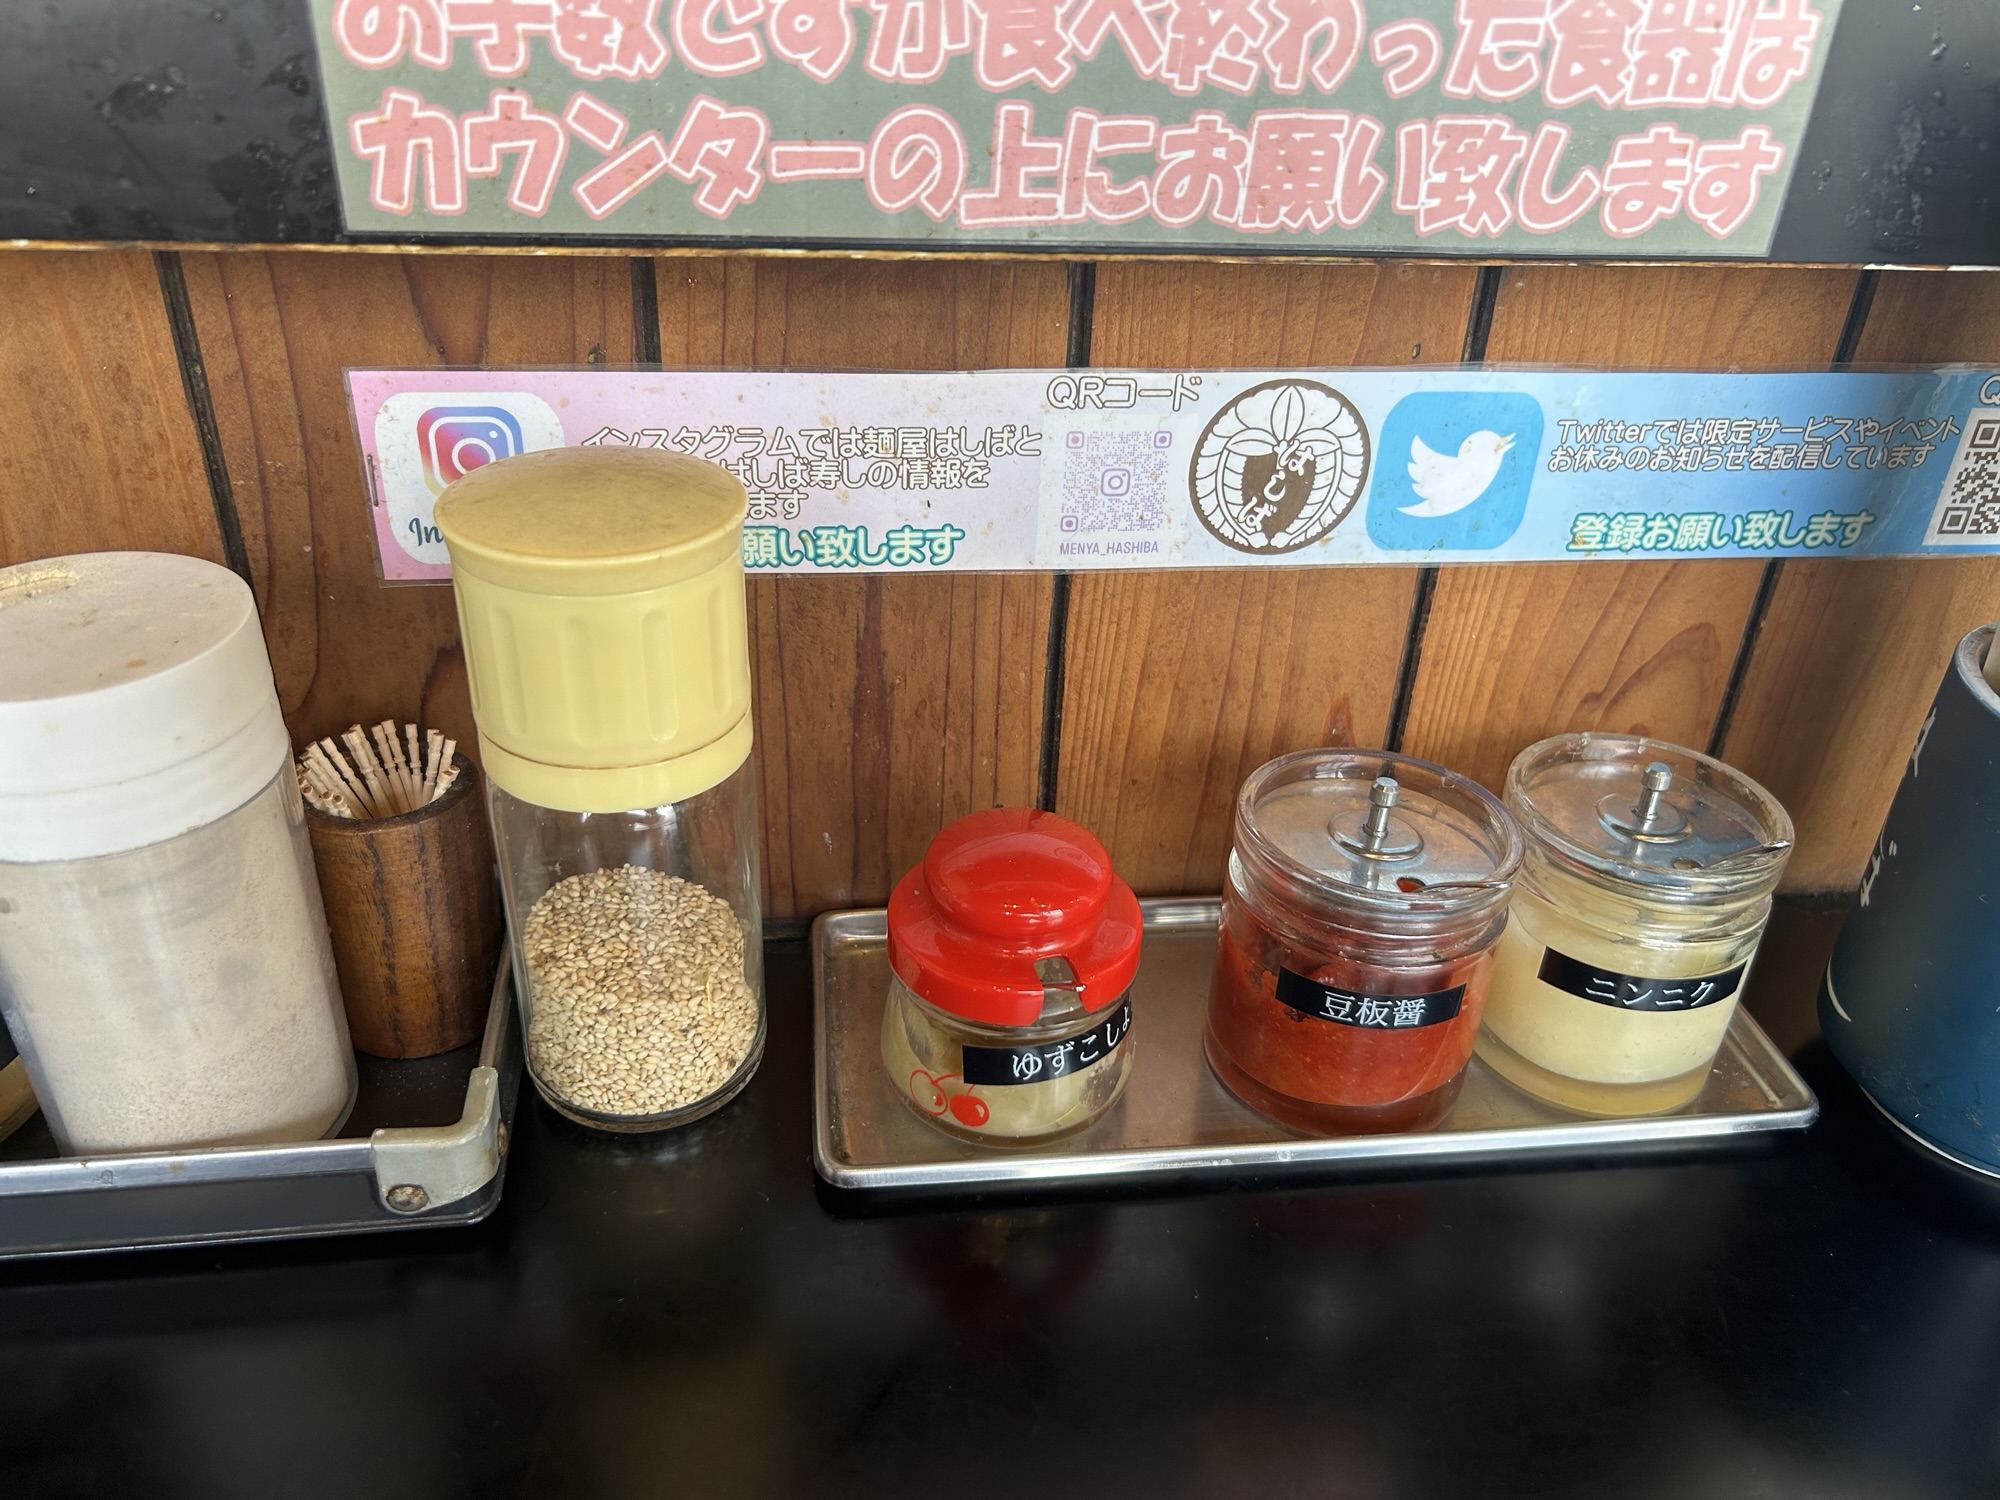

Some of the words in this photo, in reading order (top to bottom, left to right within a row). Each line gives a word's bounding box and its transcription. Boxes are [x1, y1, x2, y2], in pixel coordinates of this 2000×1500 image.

[348, 92, 1784, 240] カウンターの上にお願い致します
[1047, 375, 1202, 412] QRコード
[1557, 416, 1961, 446] Twitterでは限定サービスやイベント
[1548, 442, 1936, 472] お休みのお知らせを配信しています
[744, 488, 809, 520] ます
[1060, 540, 1159, 556] MENYA_HASHIBA
[1566, 510, 1875, 552] 登録お願い致します
[1319, 990, 1427, 1027] 豆板醤
[1585, 977, 1715, 1007] ニンニク
[1012, 1006, 1130, 1081] ゆずこしょ
